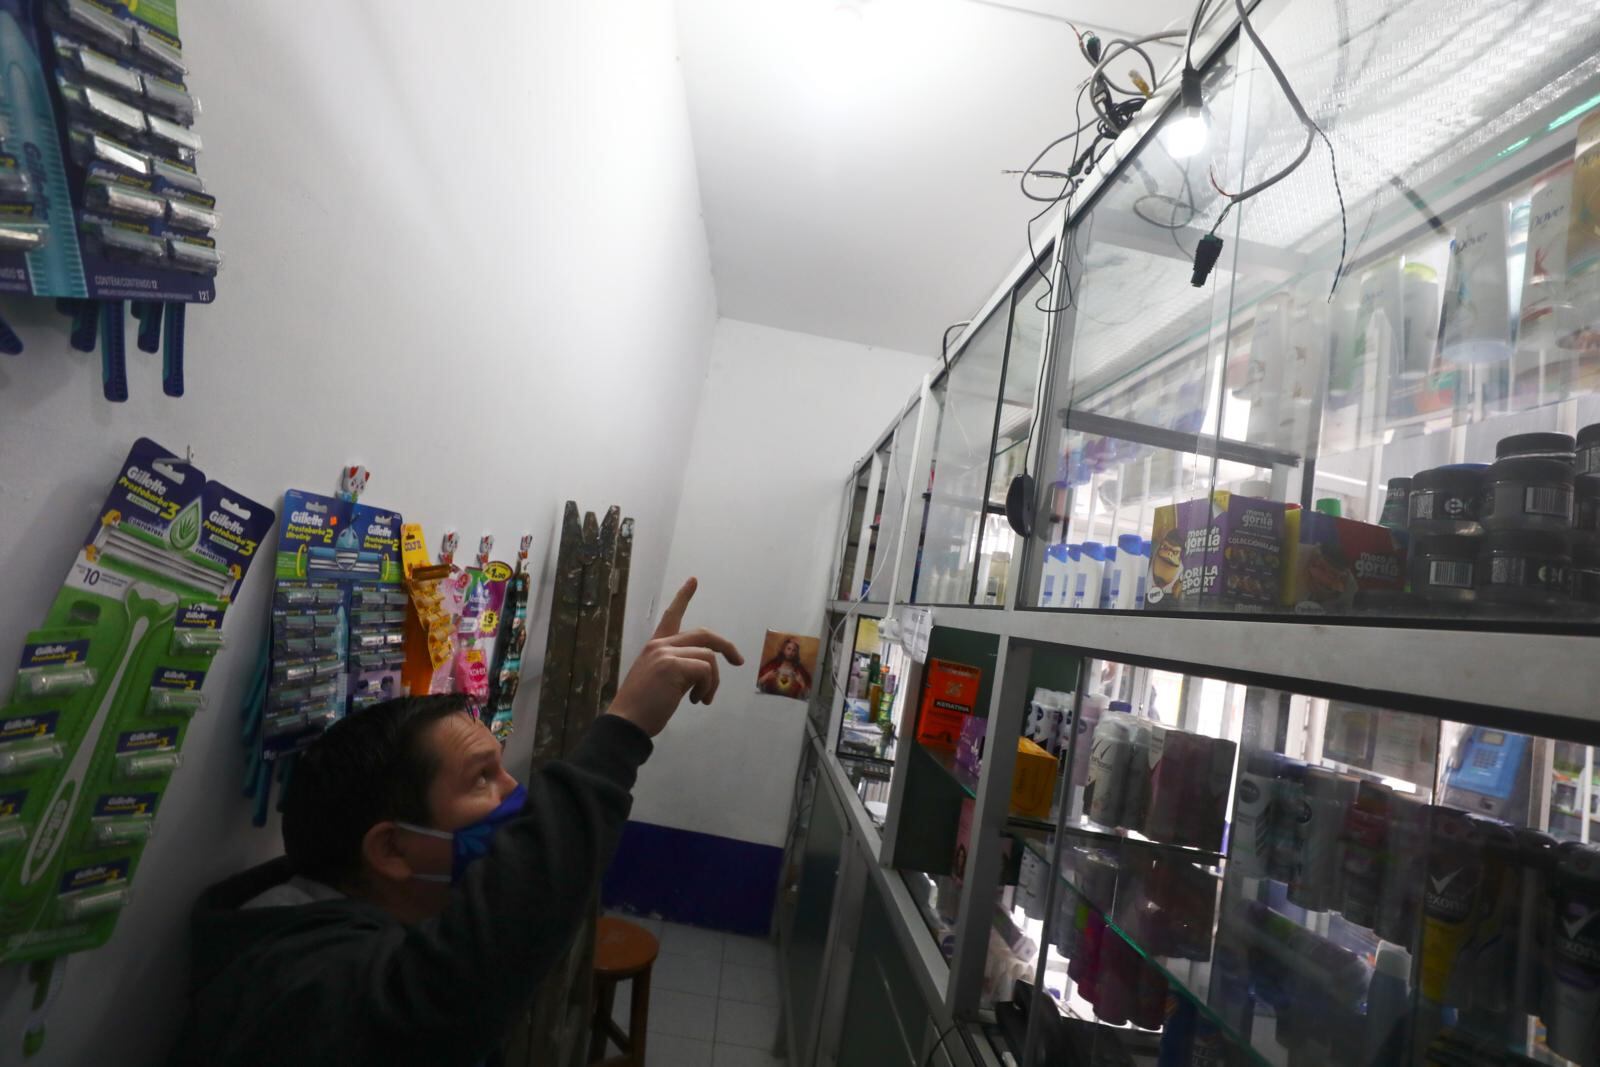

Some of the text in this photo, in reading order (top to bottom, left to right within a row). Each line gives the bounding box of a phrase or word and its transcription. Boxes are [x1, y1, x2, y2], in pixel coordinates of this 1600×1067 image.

[126, 465, 168, 495] Gillette
[159, 502, 181, 519] 3
[291, 511, 324, 527] Gillette
[208, 510, 244, 535] Gillette
[367, 524, 392, 537] Gillette
[323, 529, 334, 543] 2
[239, 538, 257, 556] 3
[82, 568, 100, 586] 10
